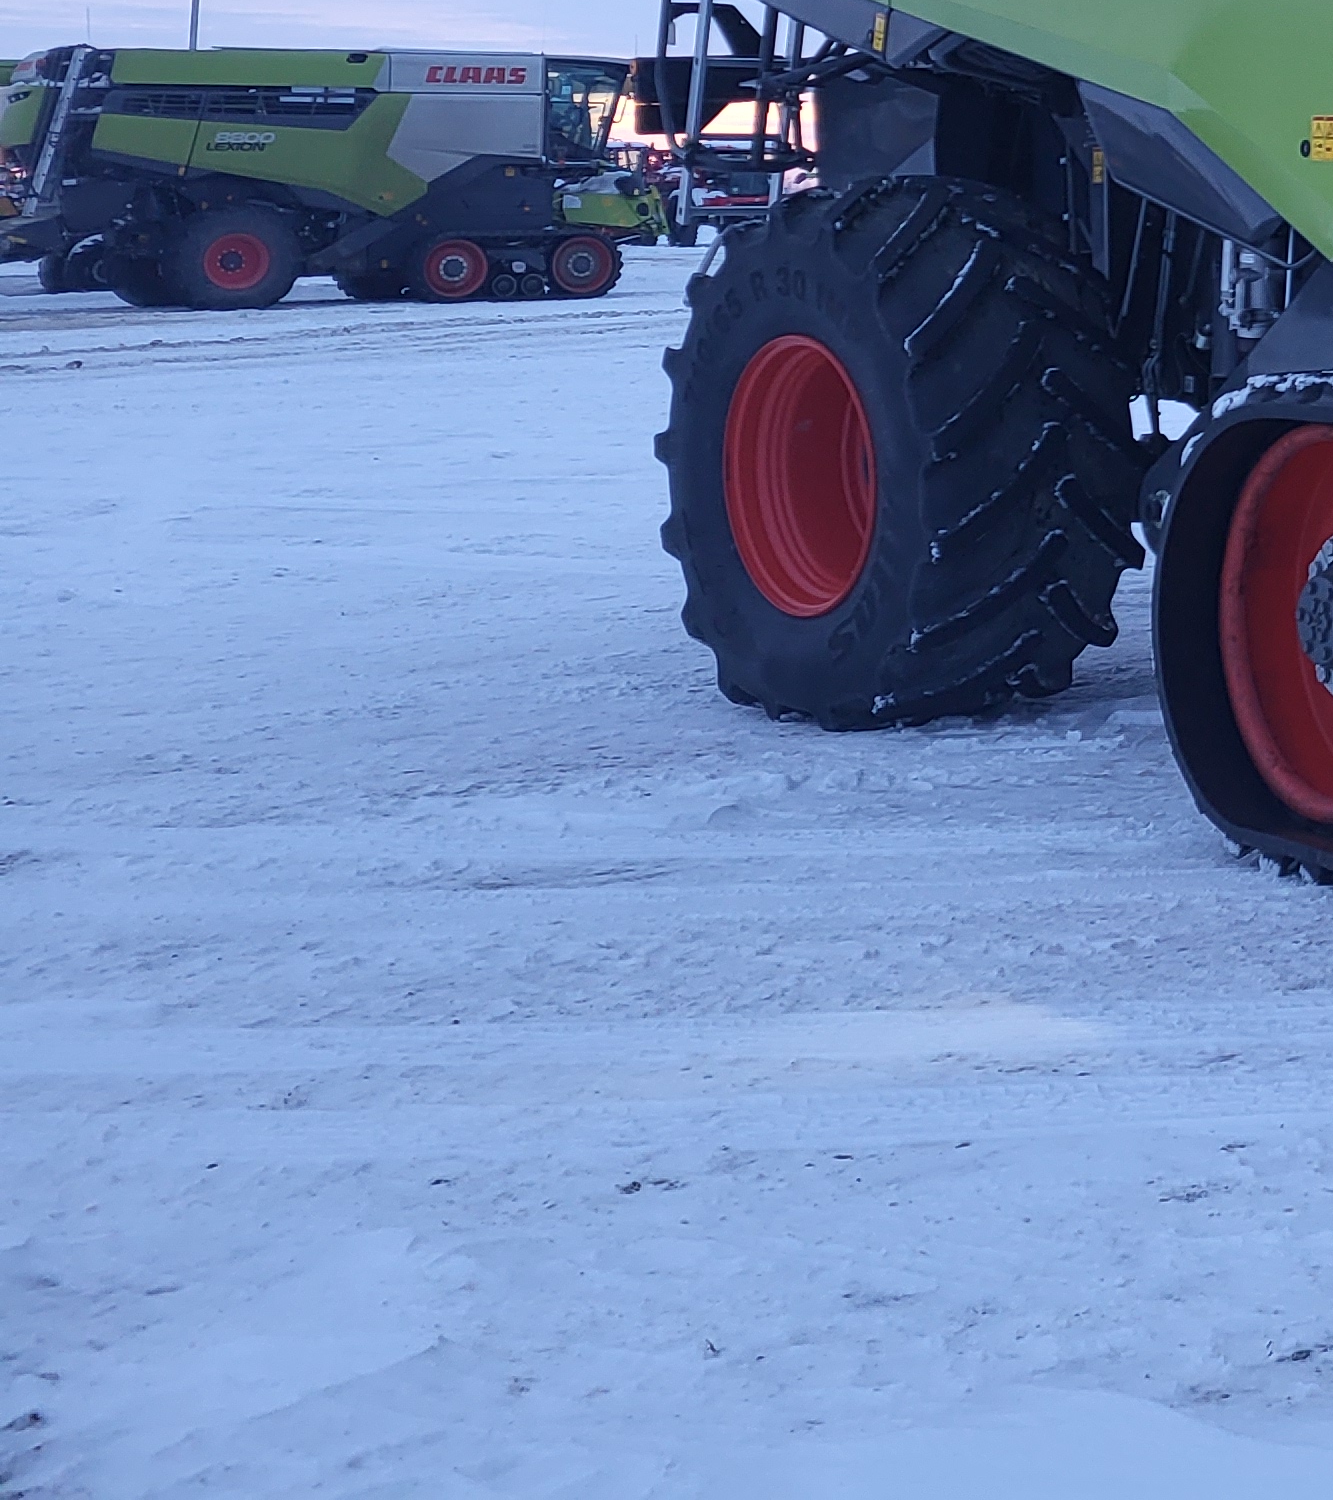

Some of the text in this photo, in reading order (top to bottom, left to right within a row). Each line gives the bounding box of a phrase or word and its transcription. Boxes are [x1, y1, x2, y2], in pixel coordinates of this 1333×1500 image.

[425, 65, 527, 84] CLAAS
[207, 142, 267, 151] LEXION
[750, 267, 768, 302] R
[776, 263, 808, 302] 30
